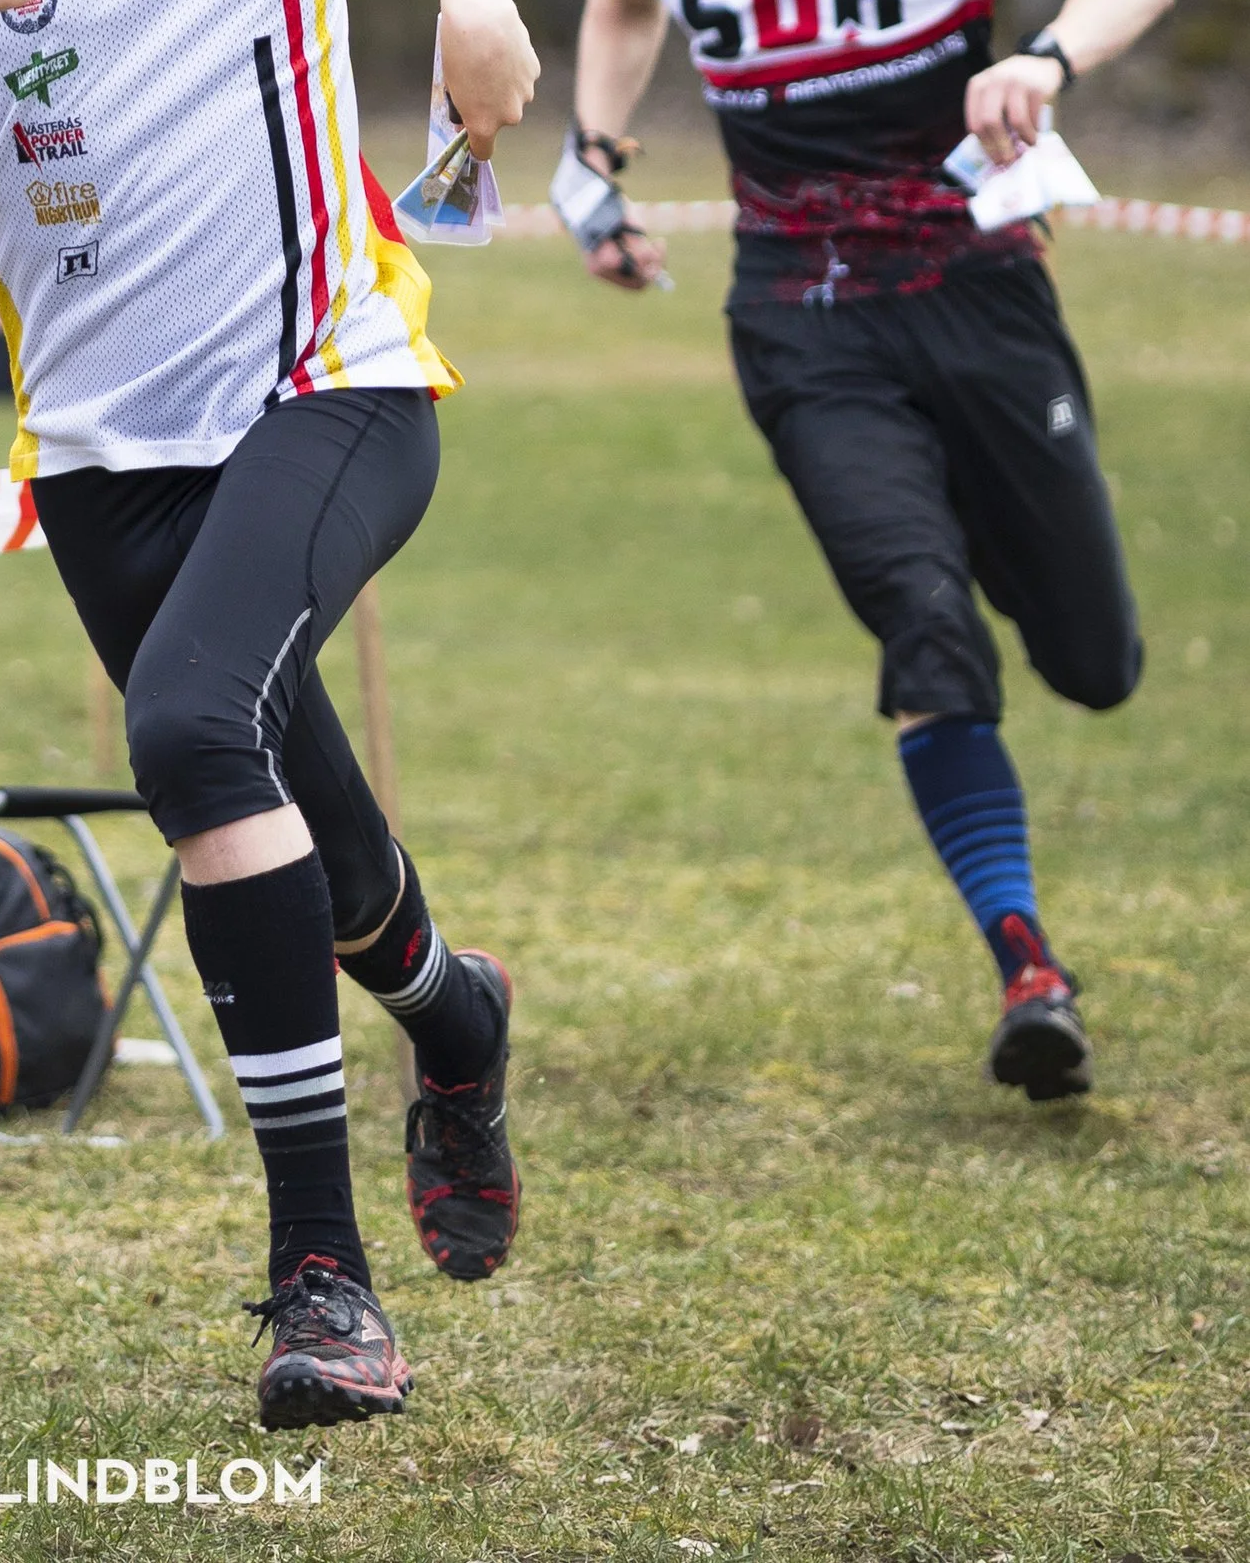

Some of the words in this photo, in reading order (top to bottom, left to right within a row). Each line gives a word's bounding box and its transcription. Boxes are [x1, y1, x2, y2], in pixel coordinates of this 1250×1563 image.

[23, 117, 82, 135] VÄSTERÅS
[30, 128, 85, 147] POWER
[36, 141, 88, 162] TRAIL
[53, 181, 96, 206] fire
